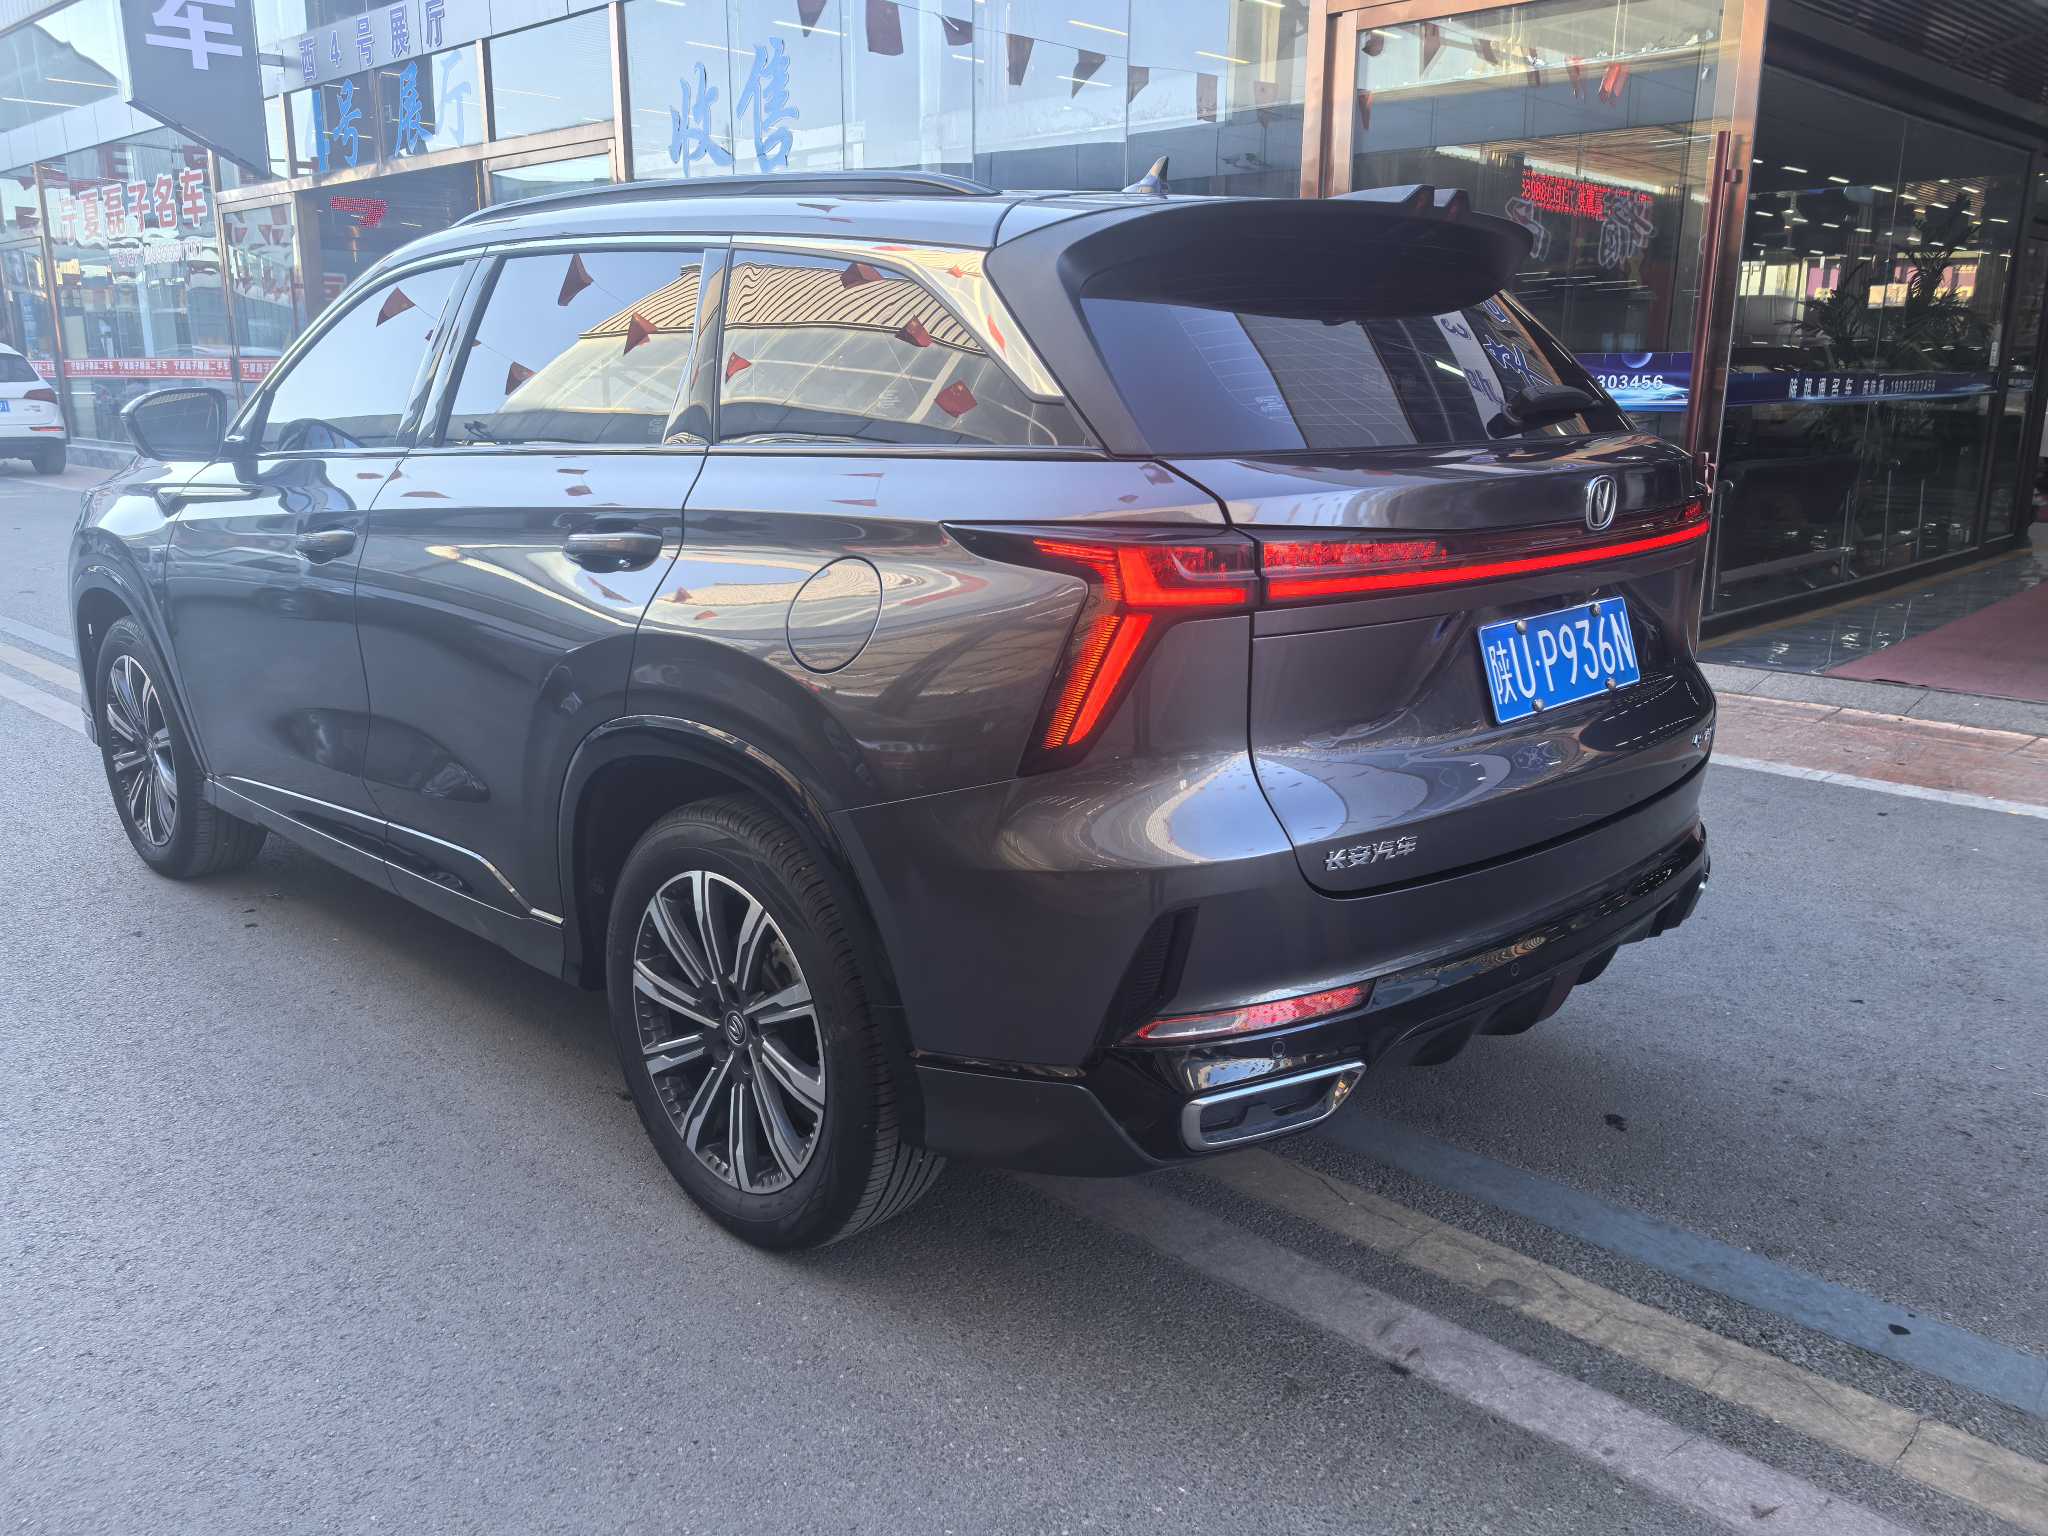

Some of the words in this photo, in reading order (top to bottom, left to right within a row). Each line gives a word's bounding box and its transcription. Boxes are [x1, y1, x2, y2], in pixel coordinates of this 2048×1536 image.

[299, 0, 446, 82] 西4号展厅
[1325, 836, 1418, 871] 长安汽车
